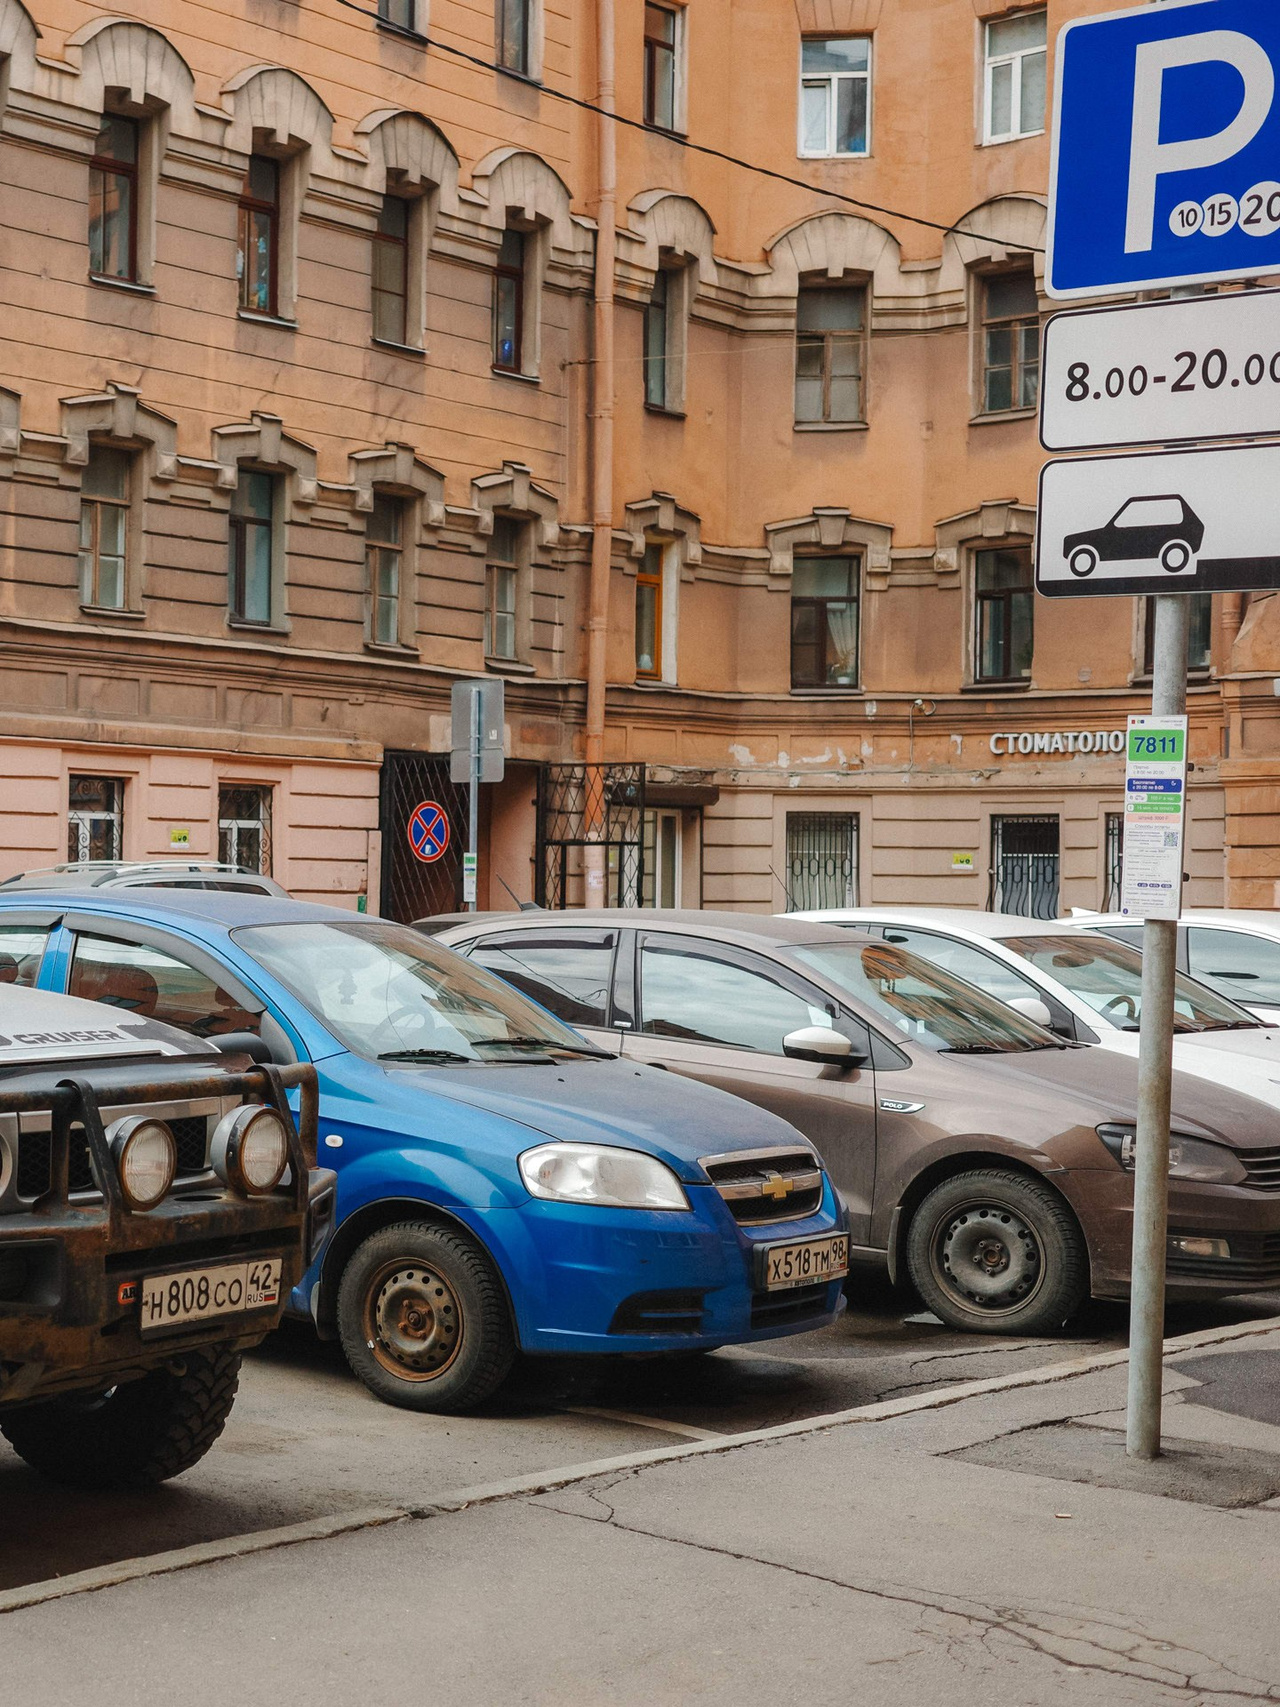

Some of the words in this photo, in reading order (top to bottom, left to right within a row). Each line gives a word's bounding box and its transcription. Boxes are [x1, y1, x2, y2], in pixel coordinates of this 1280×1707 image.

[1124, 29, 1275, 254] P
[1178, 208, 1198, 228] 10
[1207, 201, 1231, 226] 15
[1243, 191, 1280, 225] 20
[989, 730, 1127, 755] СТОМАТОЛО
[1134, 736, 1176, 754] 7811
[13, 1029, 124, 1045] CRUISER
[831, 1239, 844, 1262] 98
[249, 1262, 272, 1292] 42
[121, 1286, 136, 1300] AR
[247, 1292, 264, 1304] RUS
